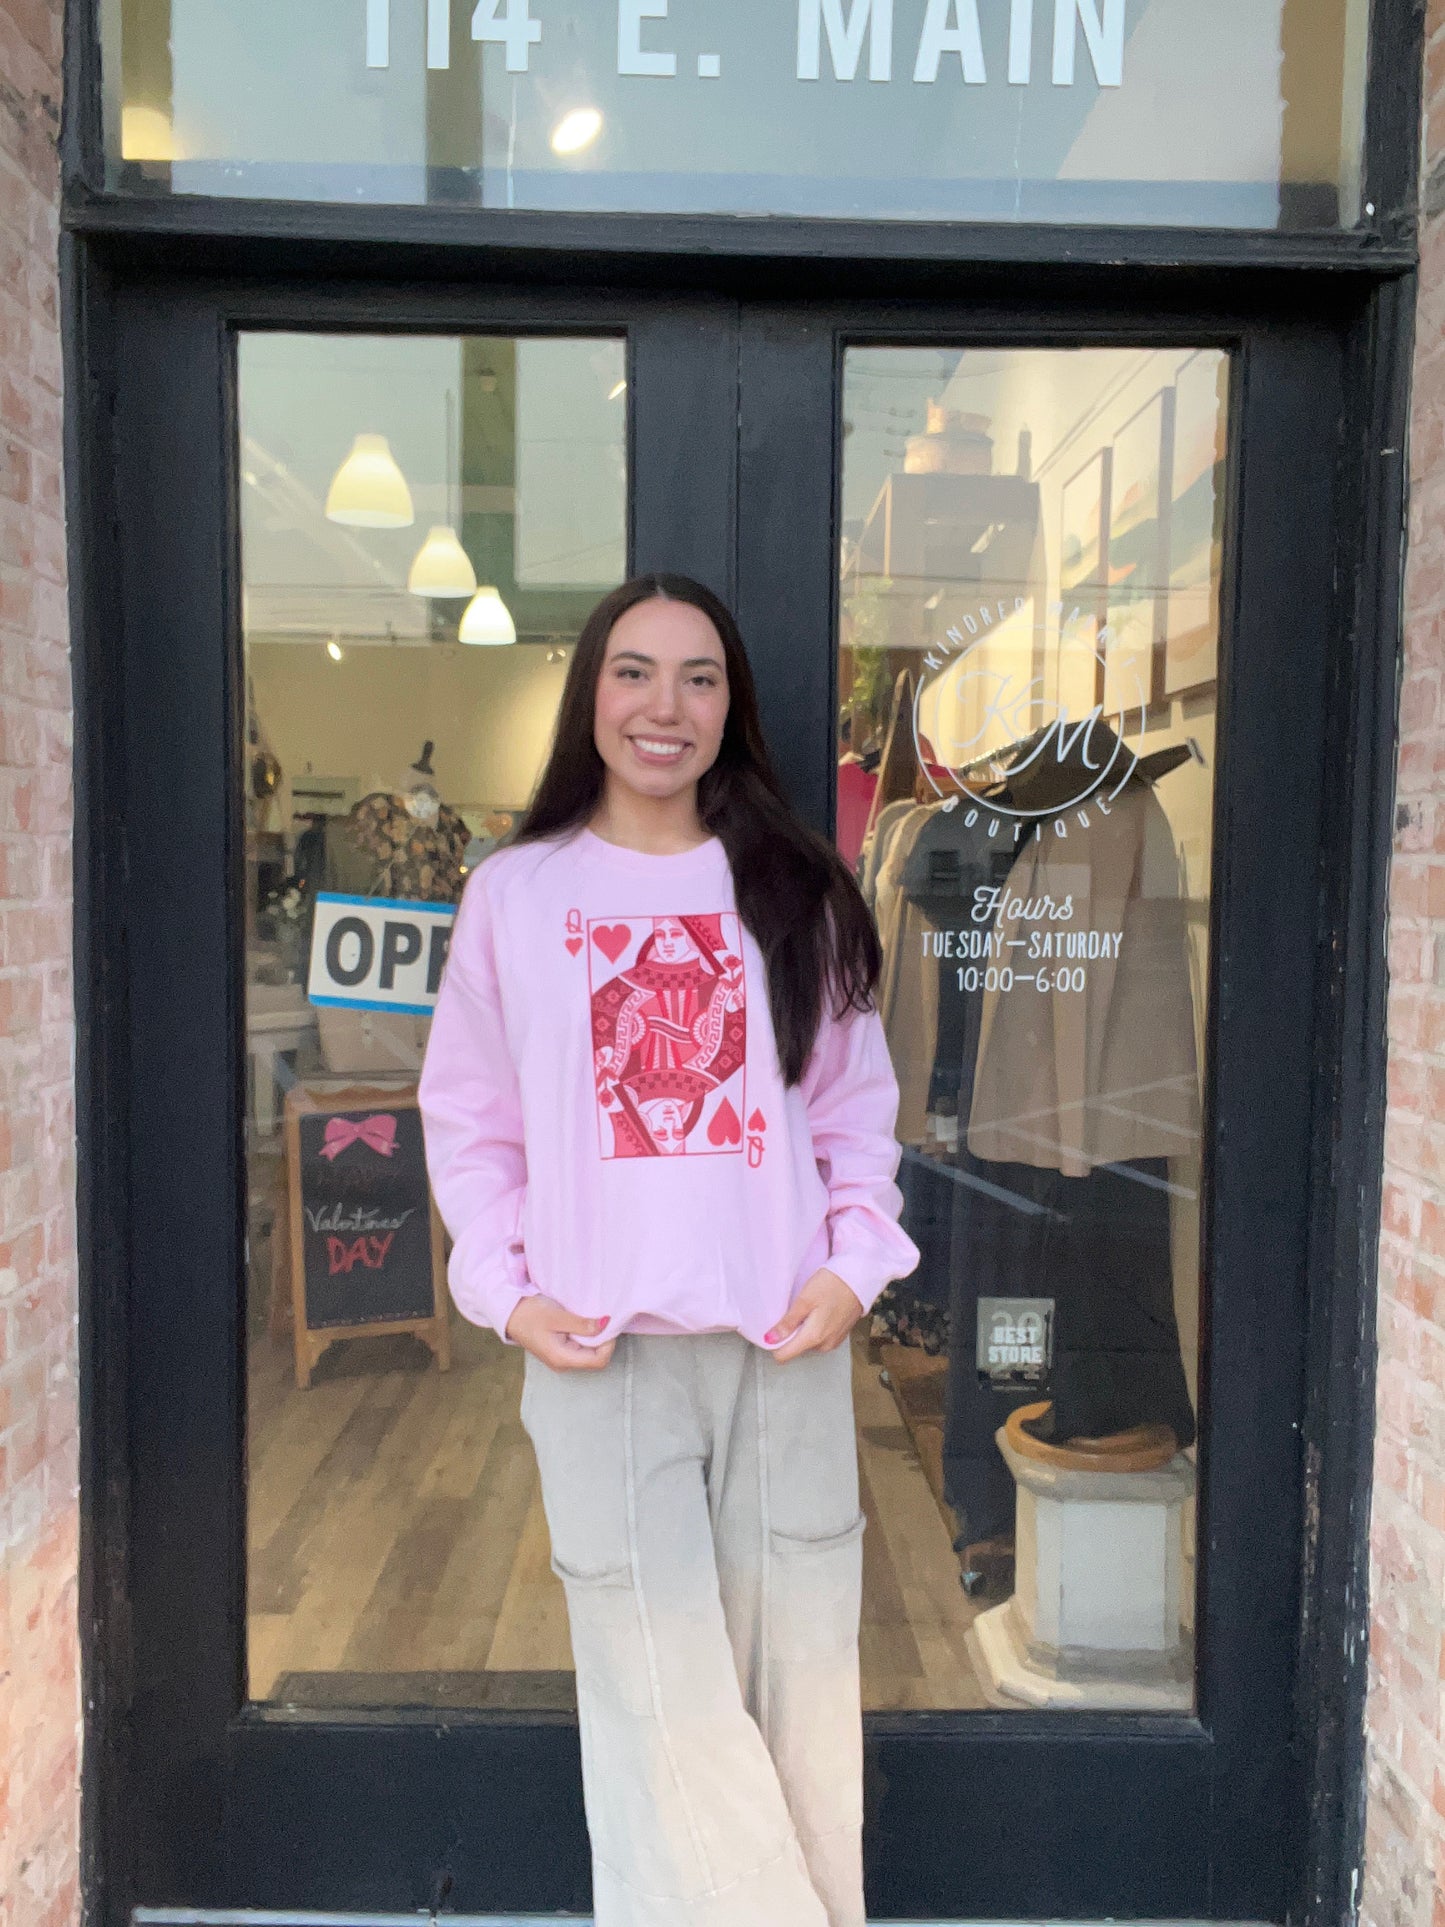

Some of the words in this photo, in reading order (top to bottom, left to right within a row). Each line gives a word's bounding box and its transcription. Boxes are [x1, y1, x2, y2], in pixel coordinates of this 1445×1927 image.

[796, 0, 1125, 85] MAIN
[942, 794, 1112, 842] BOUTIQUE
[565, 908, 584, 933] Q
[970, 885, 1073, 928] Hours
[746, 1136, 765, 1168] Q
[326, 1231, 395, 1276] DAY
[993, 1326, 1037, 1344] BEST
[988, 1345, 1042, 1363] STORE
